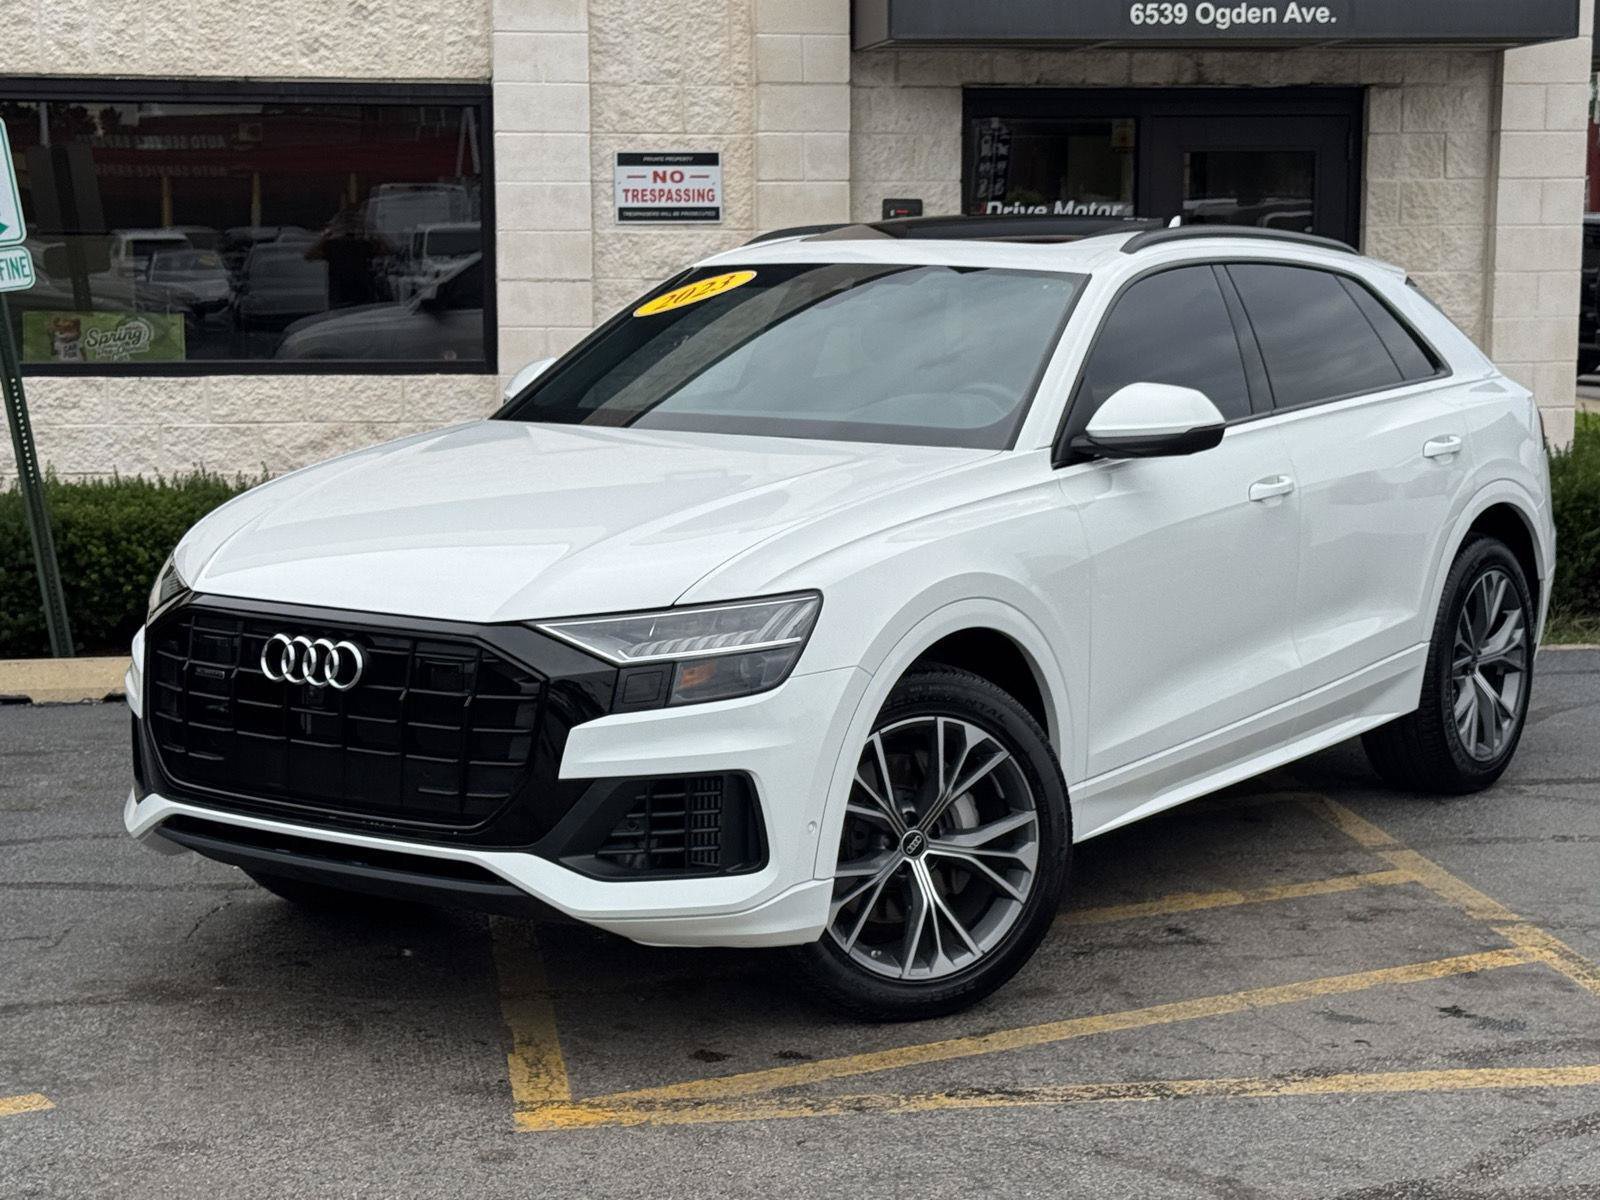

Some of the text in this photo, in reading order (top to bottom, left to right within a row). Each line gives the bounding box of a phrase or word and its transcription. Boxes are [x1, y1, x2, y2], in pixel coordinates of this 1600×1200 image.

[1130, 2, 1337, 30] 6539 Ogden Ave.
[652, 170, 685, 184] NO
[622, 188, 716, 203] TRESPASSING
[0, 256, 31, 282] FINE
[86, 327, 143, 347] Spring
